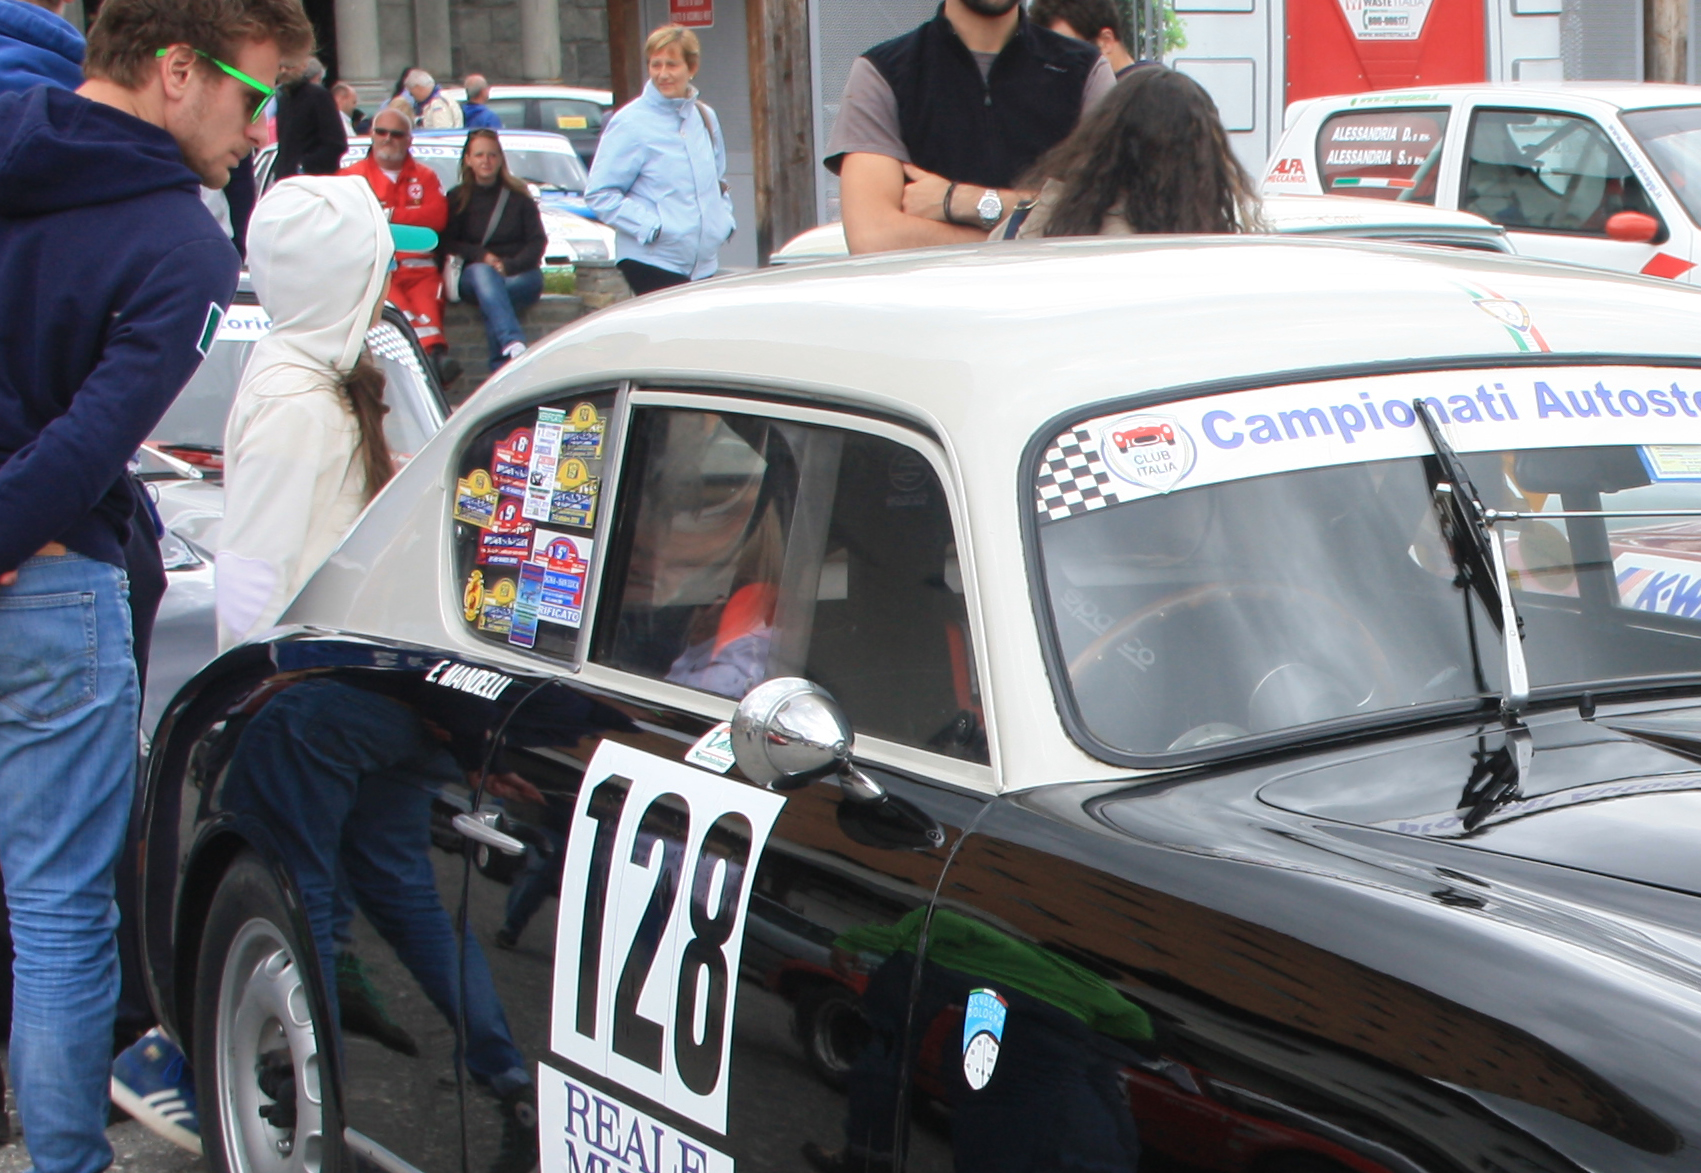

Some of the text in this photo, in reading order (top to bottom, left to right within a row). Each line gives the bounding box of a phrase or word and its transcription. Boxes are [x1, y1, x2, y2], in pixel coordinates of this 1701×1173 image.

[1331, 127, 1397, 141] ALESSANDRIA
[1326, 149, 1392, 165] ALESSANDRIA
[1272, 159, 1305, 174] ALFA
[1201, 382, 1518, 450] Campionati
[1133, 450, 1171, 465] CLUB
[1136, 462, 1178, 478] ITALIA
[437, 663, 514, 701] MANDELLI
[575, 773, 754, 1097] 128
